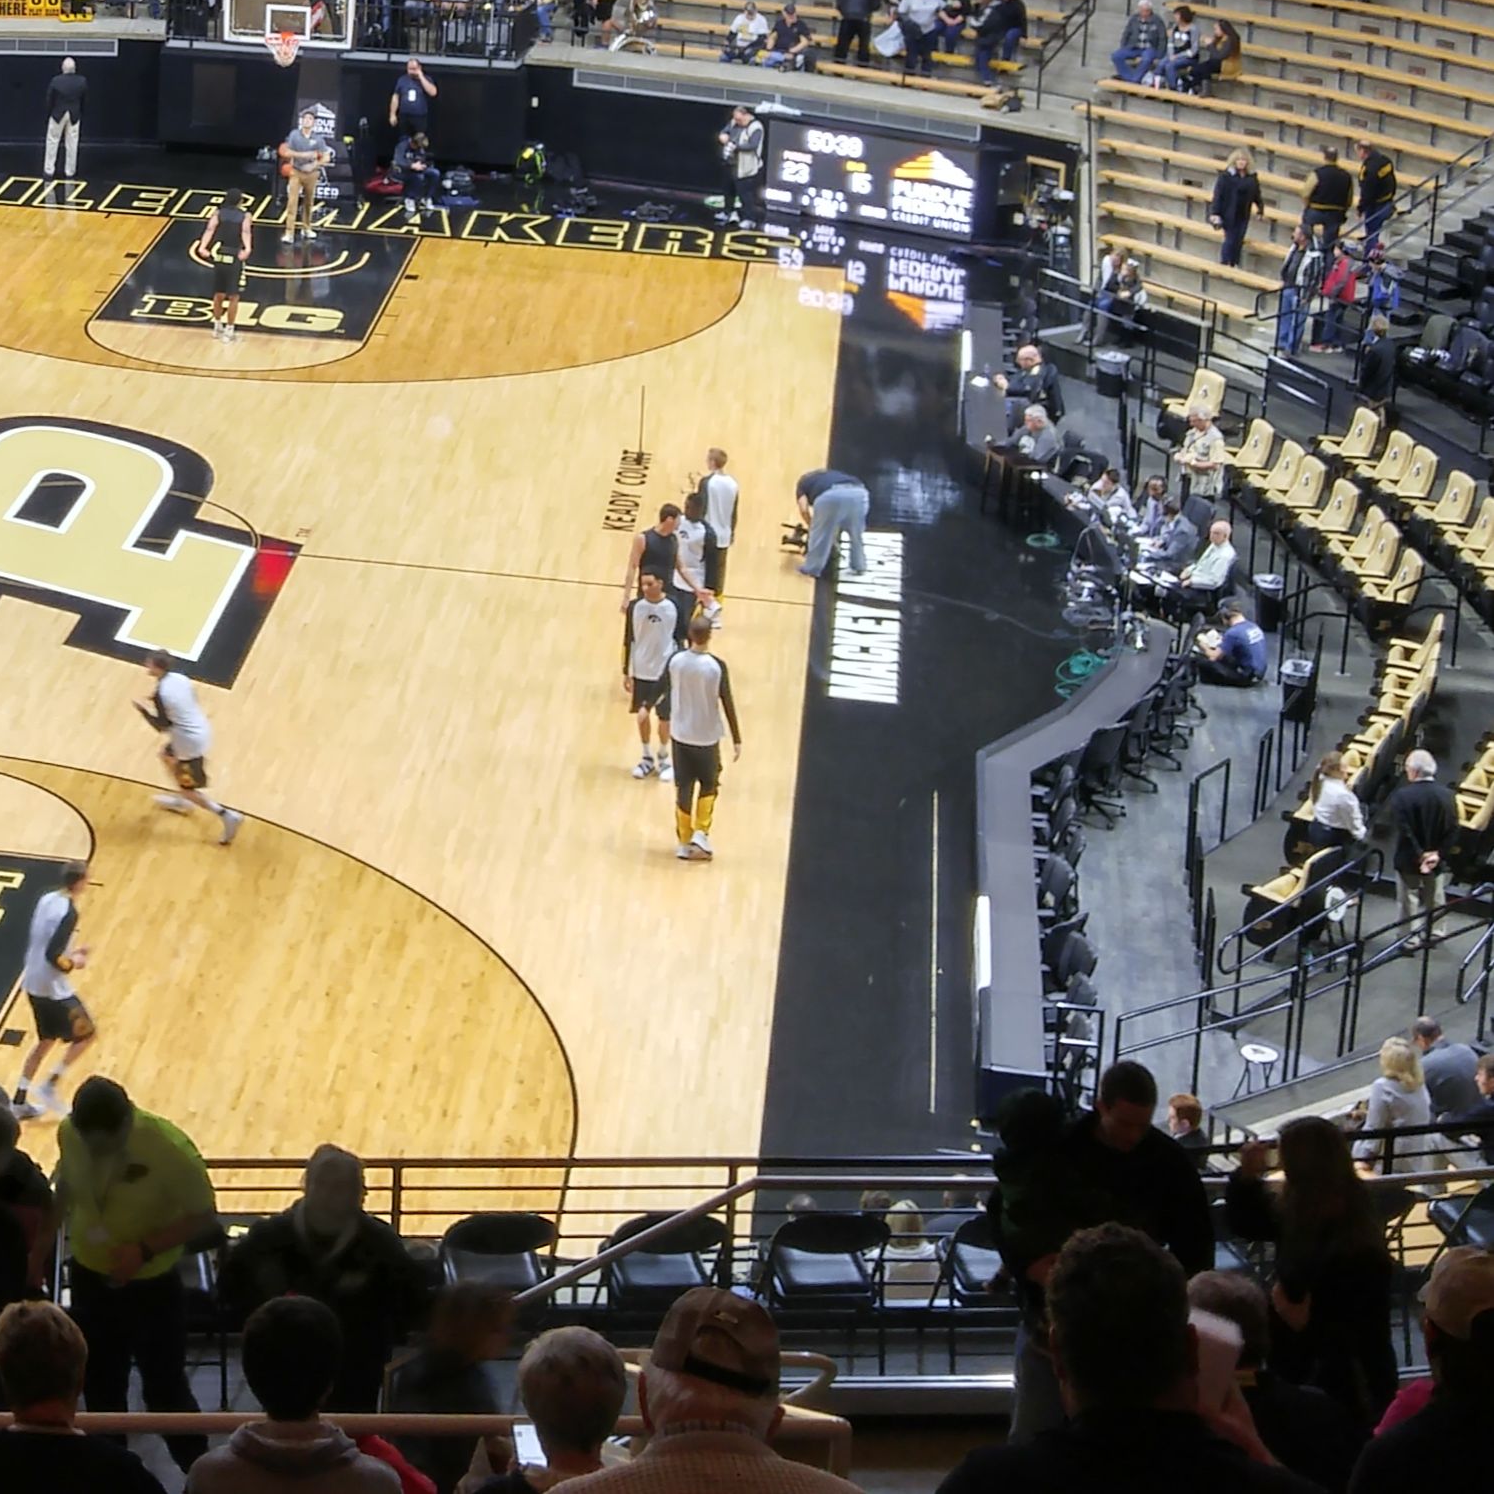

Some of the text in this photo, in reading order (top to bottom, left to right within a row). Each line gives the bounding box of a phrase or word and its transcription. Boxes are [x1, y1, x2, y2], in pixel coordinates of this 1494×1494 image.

[851, 171, 873, 195] 15
[892, 178, 974, 209] PURDUE
[892, 194, 972, 223] FEDERAL
[892, 210, 971, 234] CREDIT UNION
[615, 449, 653, 488] COURT
[602, 488, 641, 533] KEADY
[827, 600, 902, 705] MACKEY
